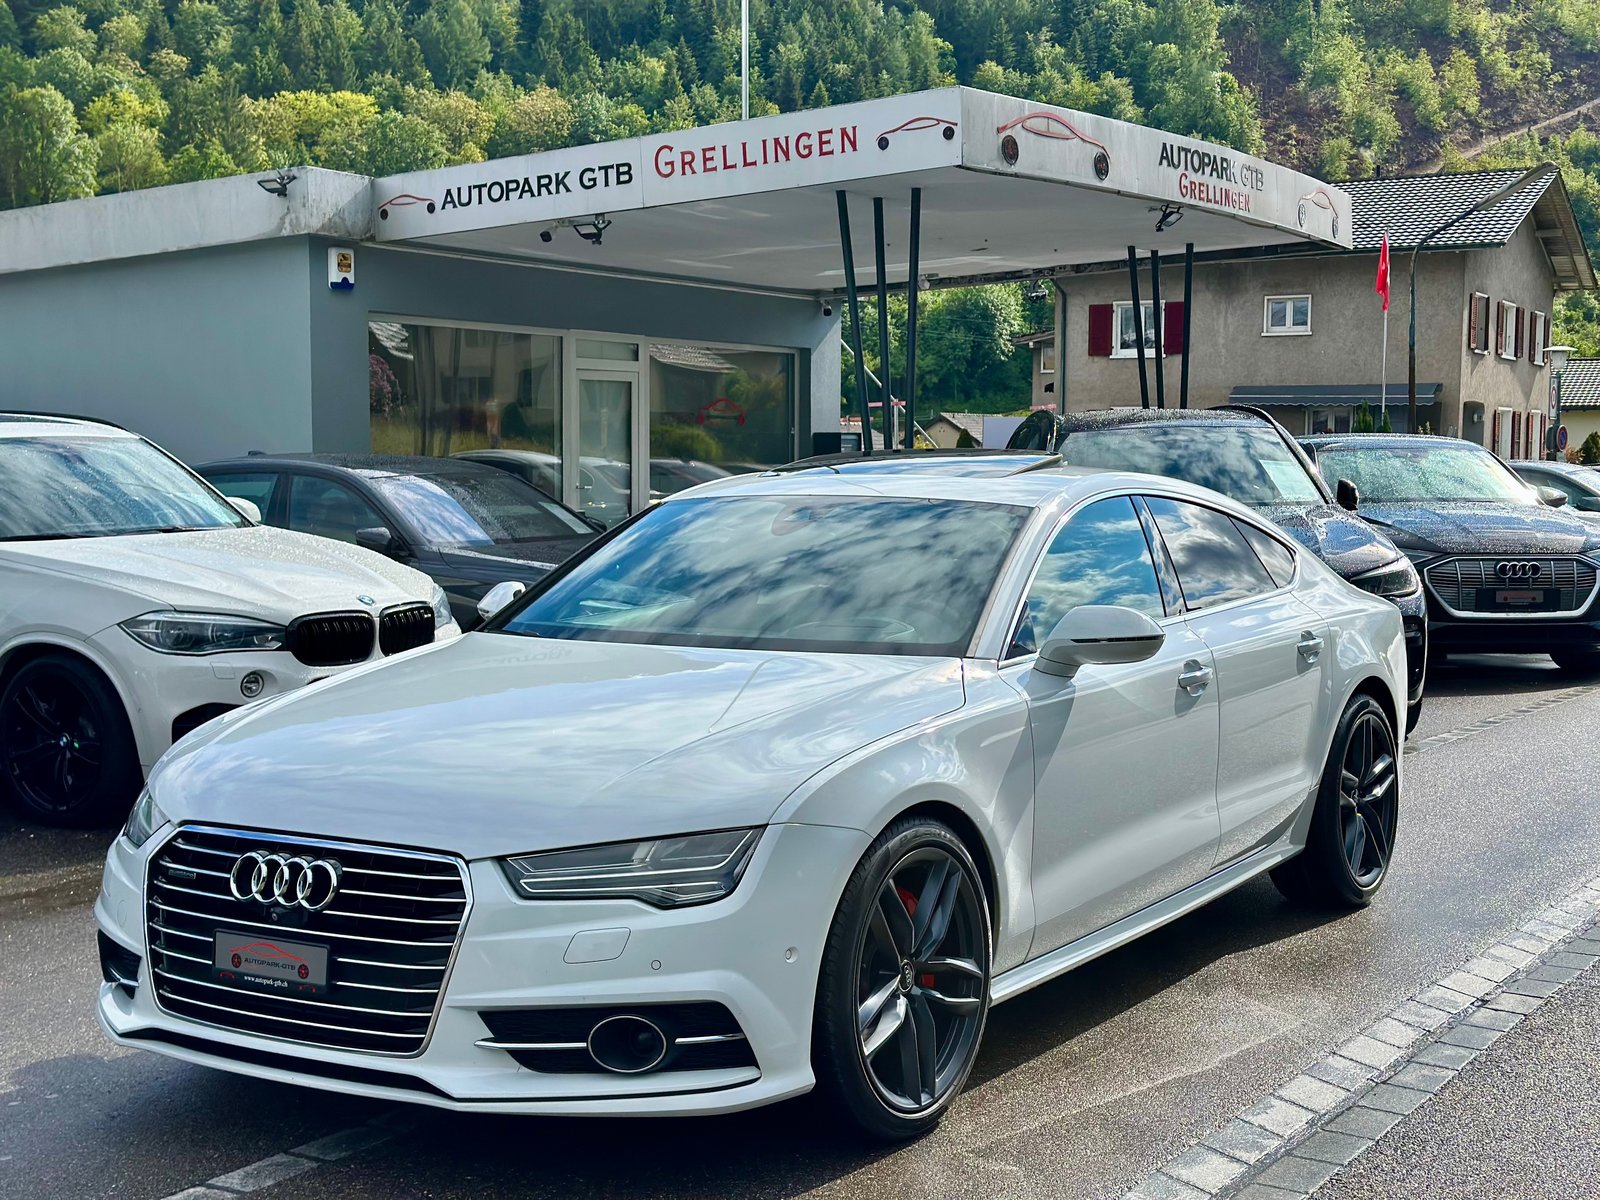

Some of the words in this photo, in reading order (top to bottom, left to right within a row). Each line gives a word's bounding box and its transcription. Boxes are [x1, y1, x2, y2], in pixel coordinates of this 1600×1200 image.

[654, 125, 858, 178] GRELLINGEN
[1159, 142, 1238, 184] AUTOPARK
[1241, 163, 1264, 191] GTB
[441, 171, 572, 210] AUTOPARK
[579, 162, 633, 190] GTB
[1179, 172, 1251, 213] GRELLINGEN
[244, 957, 296, 971] AUTOPARK-GTB
